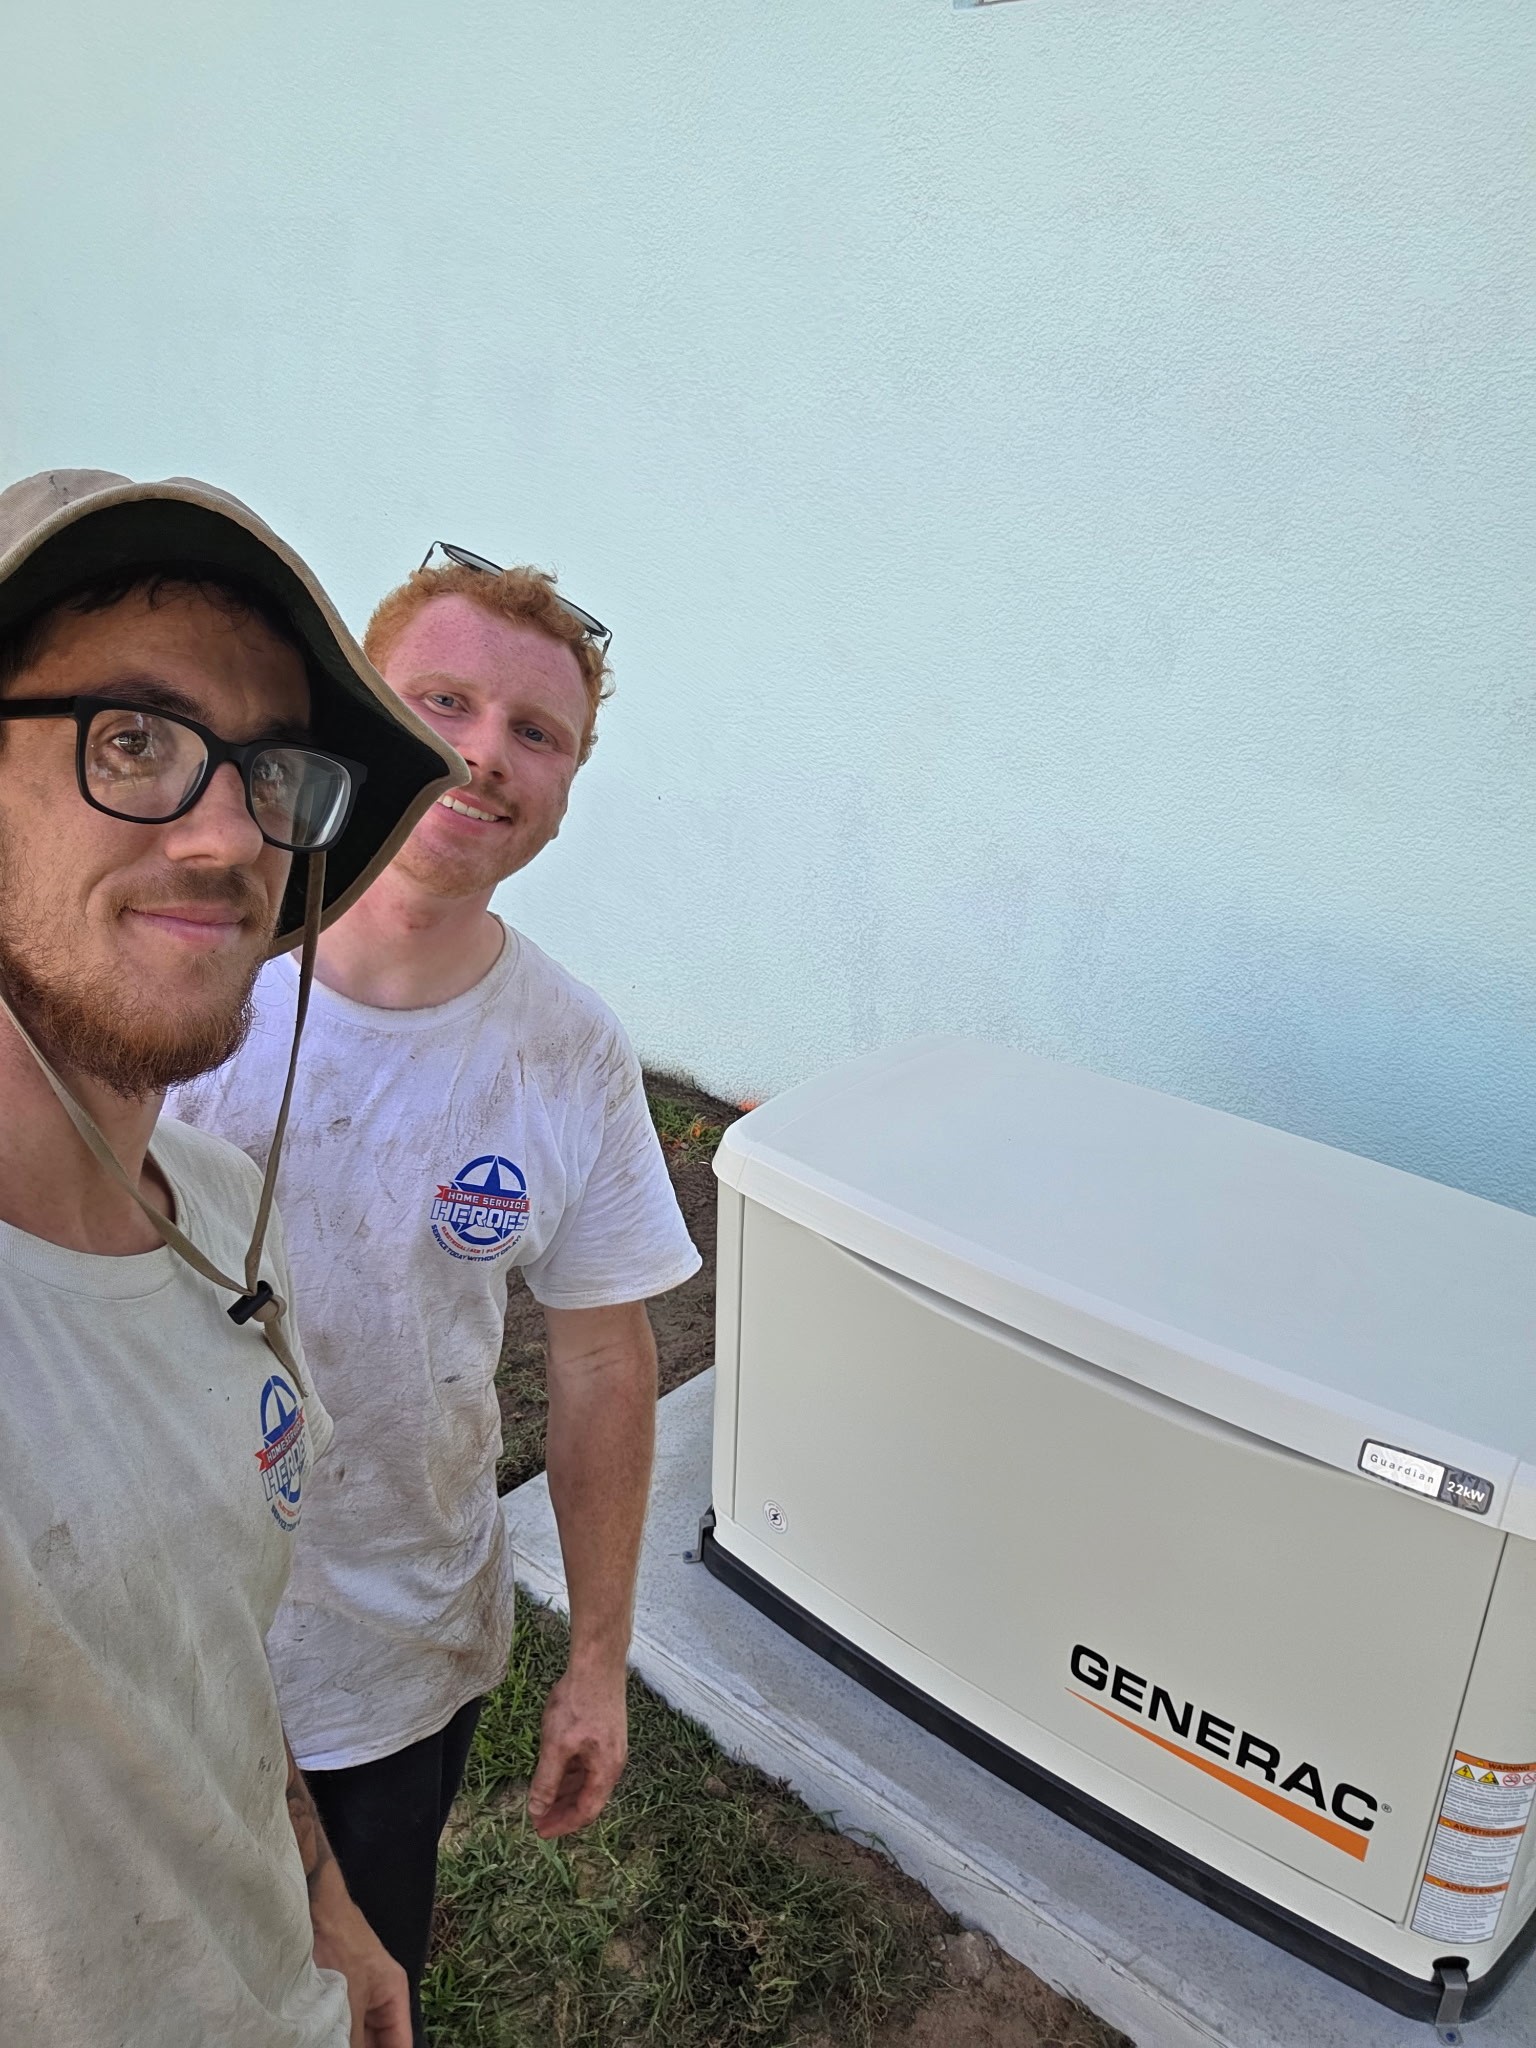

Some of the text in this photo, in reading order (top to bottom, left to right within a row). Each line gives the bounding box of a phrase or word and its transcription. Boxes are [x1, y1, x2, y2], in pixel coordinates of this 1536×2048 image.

[430, 1199, 530, 1231] HEROES
[447, 1191, 527, 1210] HOME SERVICE
[431, 1224, 448, 1251] SERVICE
[446, 1247, 466, 1260] TODAY
[467, 1252, 500, 1262] WITHOUT
[266, 1440, 289, 1462] HOME
[1370, 1454, 1434, 1483] Guardian
[1446, 1481, 1485, 1503] 22kW
[1070, 1644, 1378, 1831] GENERAC
